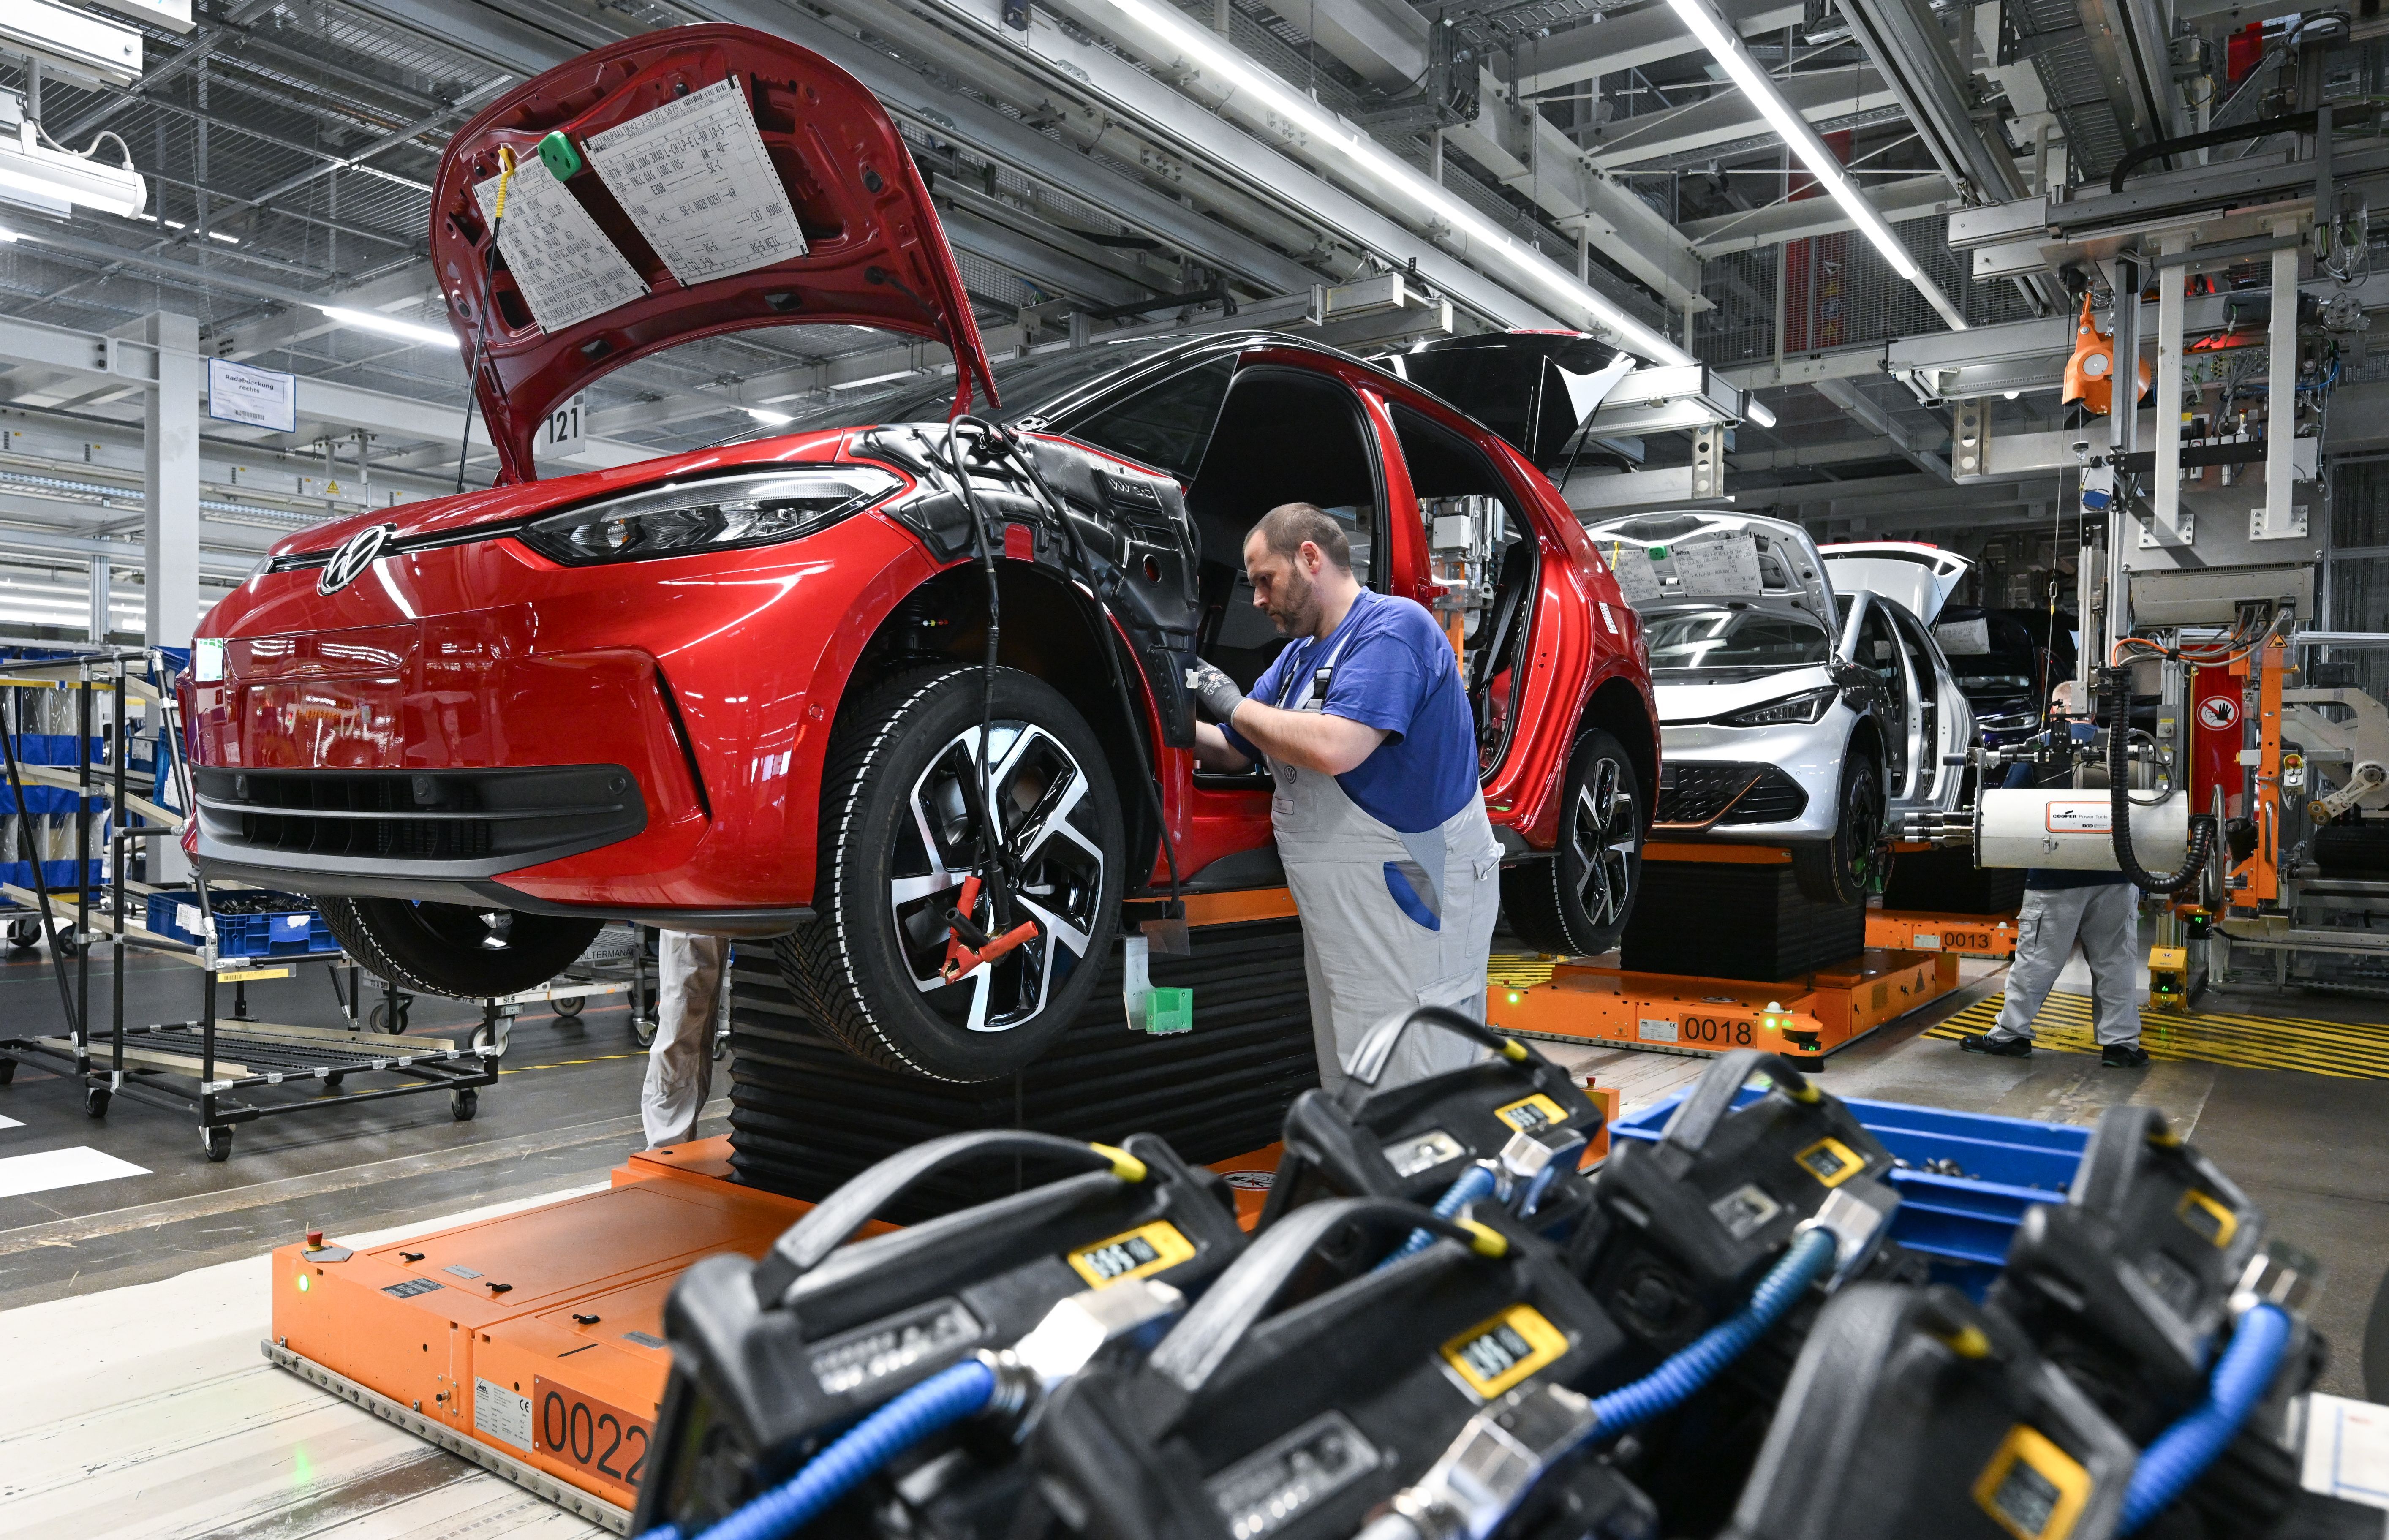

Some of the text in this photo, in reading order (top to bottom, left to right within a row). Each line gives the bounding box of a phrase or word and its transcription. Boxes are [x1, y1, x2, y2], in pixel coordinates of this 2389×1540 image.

[588, 136, 604, 148] E123
[601, 133, 611, 142] KK
[629, 112, 662, 131] 42-3-5737
[663, 104, 680, 116] 5679
[620, 161, 638, 174] 10AK
[634, 155, 651, 169] 10AG
[662, 143, 680, 157] L-CH
[677, 136, 695, 151] LP-E
[692, 130, 710, 145] L-BR
[650, 159, 723, 195] E30B 5C-C
[655, 163, 673, 177] 10BC
[225, 374, 274, 390] Radabdeckung
[239, 385, 260, 393] rechts
[547, 408, 578, 443] 121
[1109, 478, 1130, 492] VW
[1944, 933, 1989, 948] 0013
[579, 948, 634, 960] ALTERMANA
[1684, 1017, 1752, 1045] 0018
[520, 1399, 529, 1413] CE
[544, 1391, 650, 1488] 0022
